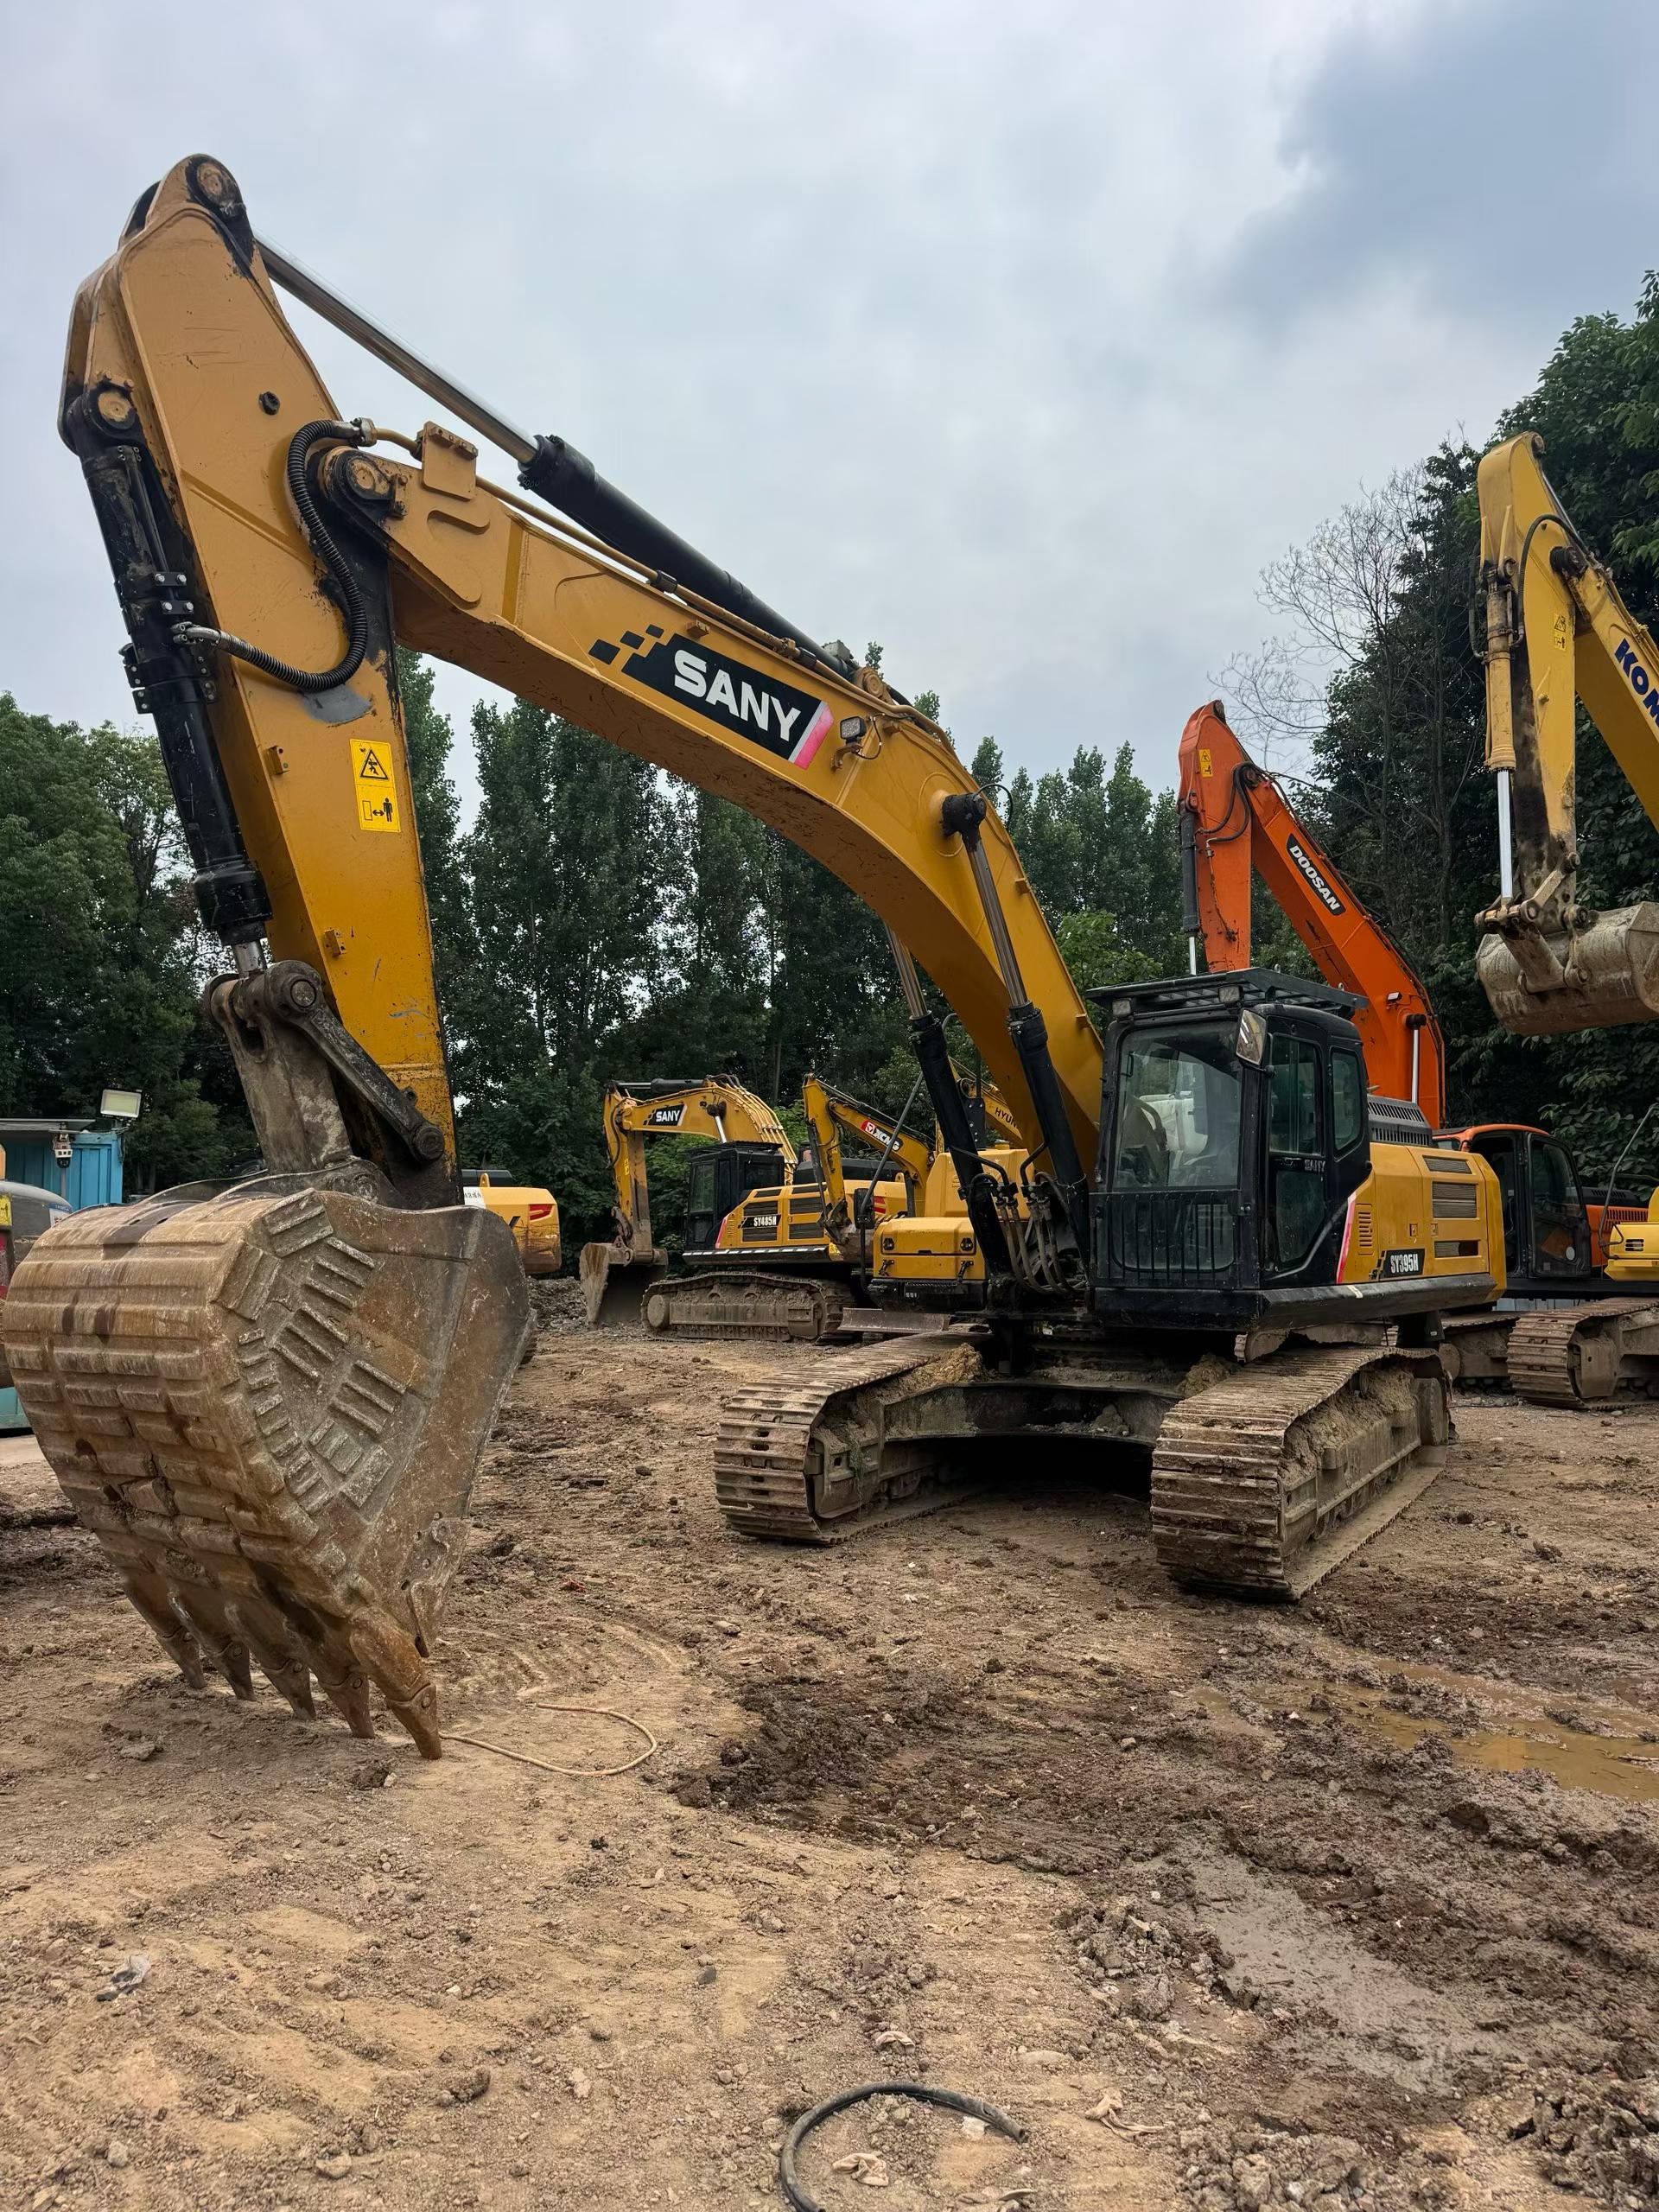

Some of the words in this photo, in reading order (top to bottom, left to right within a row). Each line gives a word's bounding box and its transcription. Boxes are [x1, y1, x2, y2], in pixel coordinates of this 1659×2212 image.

[674, 649, 801, 742] SANY
[1289, 845, 1340, 911] DOOSAN
[656, 1110, 680, 1122] SANY
[1390, 1253, 1419, 1274] SY395H
